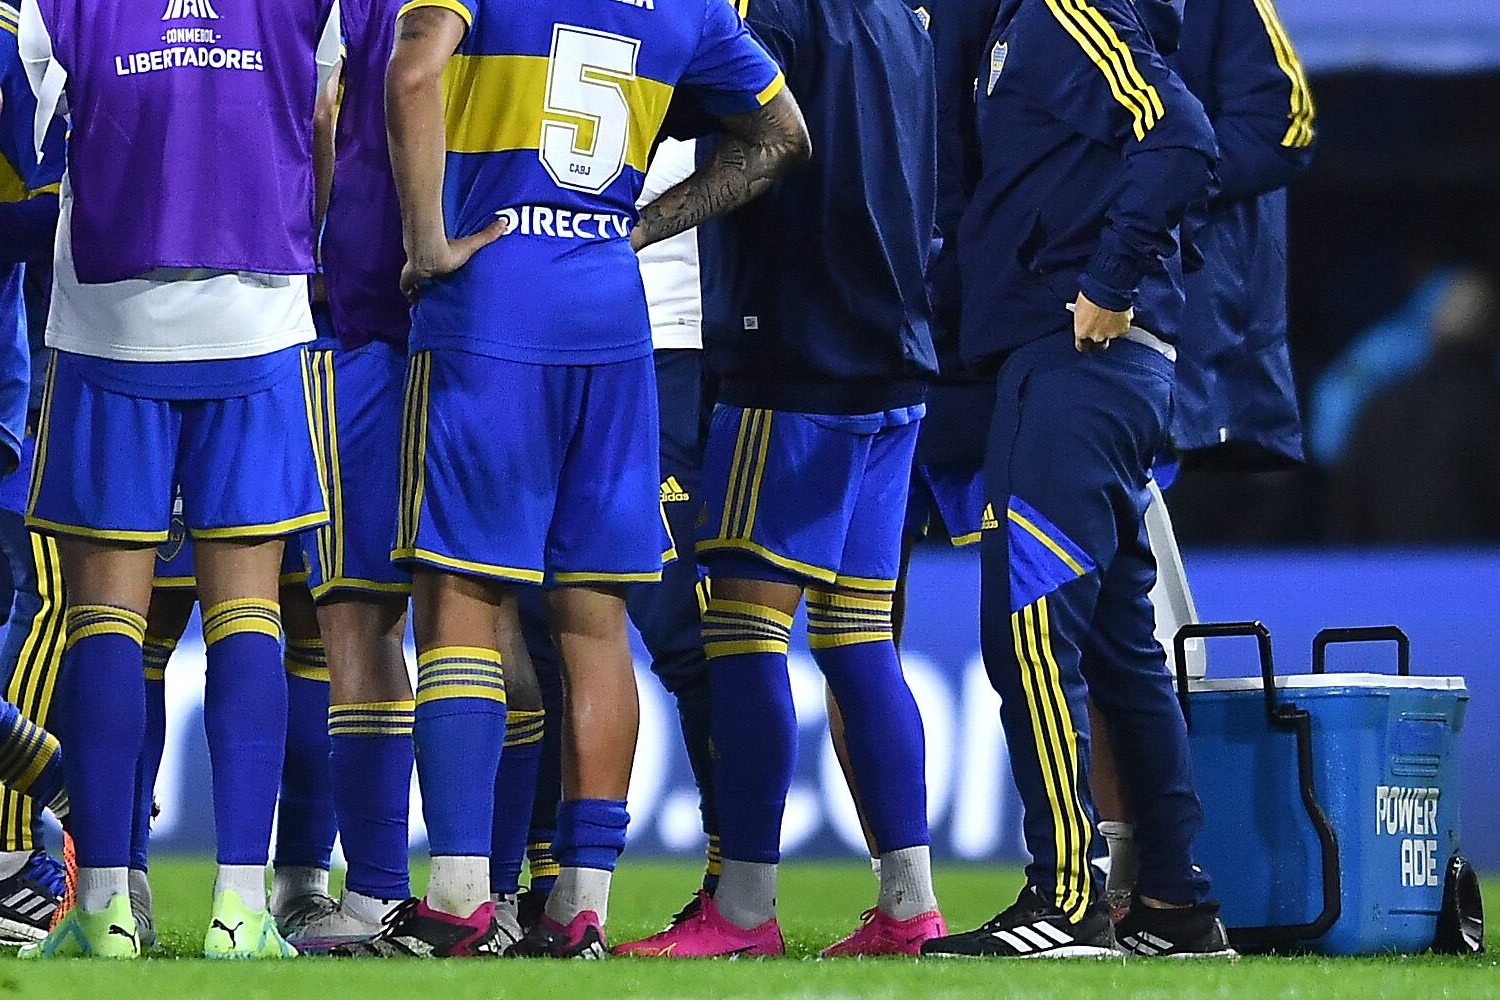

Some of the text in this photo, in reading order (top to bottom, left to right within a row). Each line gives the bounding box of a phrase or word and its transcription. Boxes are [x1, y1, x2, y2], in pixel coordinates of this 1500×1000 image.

[165, 28, 217, 44] CONMEBOL
[114, 46, 264, 76] LIBERTADORES
[538, 22, 642, 196] 5
[569, 162, 592, 176] CABJ
[494, 205, 630, 240] DIRECTV
[1376, 785, 1440, 836] POWER
[1401, 838, 1438, 888] ADE
